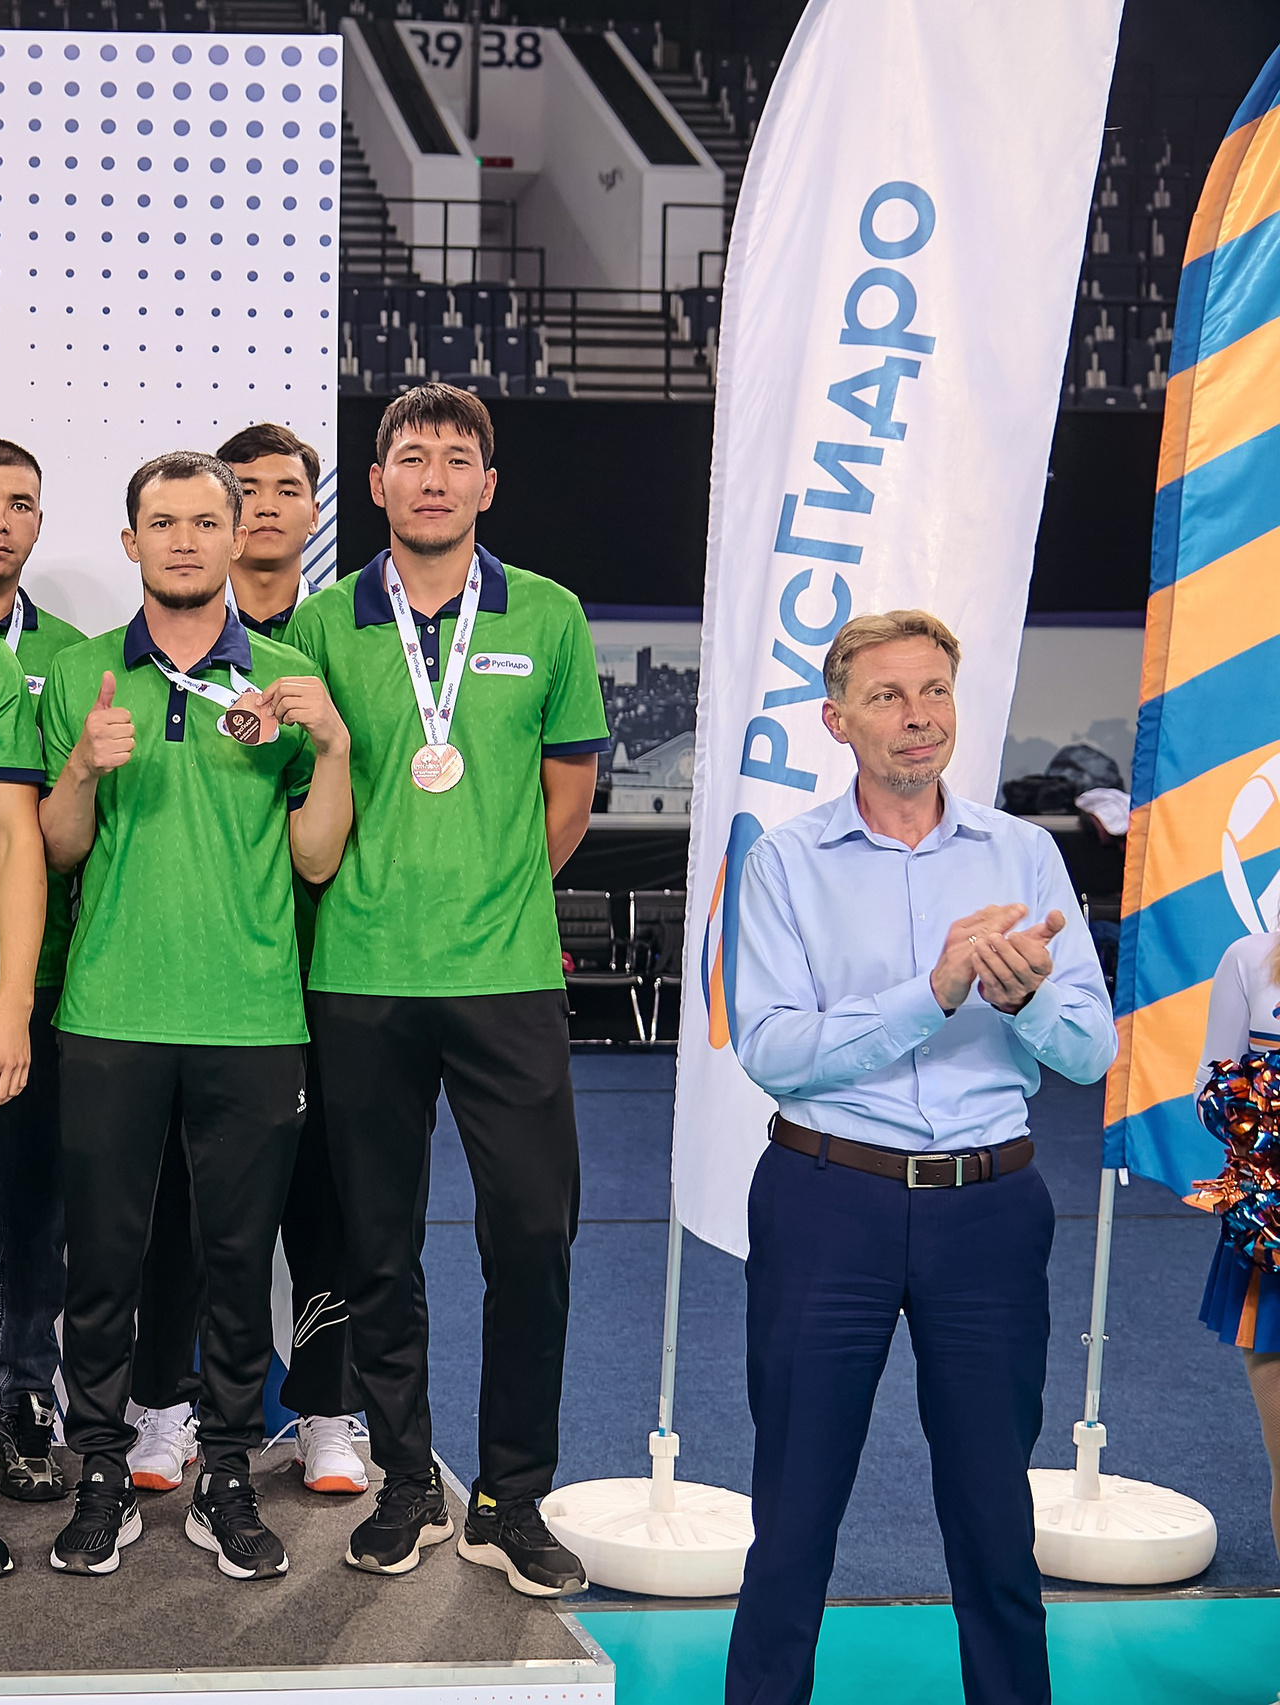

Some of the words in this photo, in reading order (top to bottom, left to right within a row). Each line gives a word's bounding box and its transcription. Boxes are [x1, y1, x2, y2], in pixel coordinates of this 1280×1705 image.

[480, 31, 543, 69] 3.8
[740, 180, 937, 793] РусГидро
[459, 617, 469, 643] РусГидро
[412, 653, 422, 679] РусГидро
[491, 659, 529, 670] РусГидро
[443, 682, 454, 708] РусГидро
